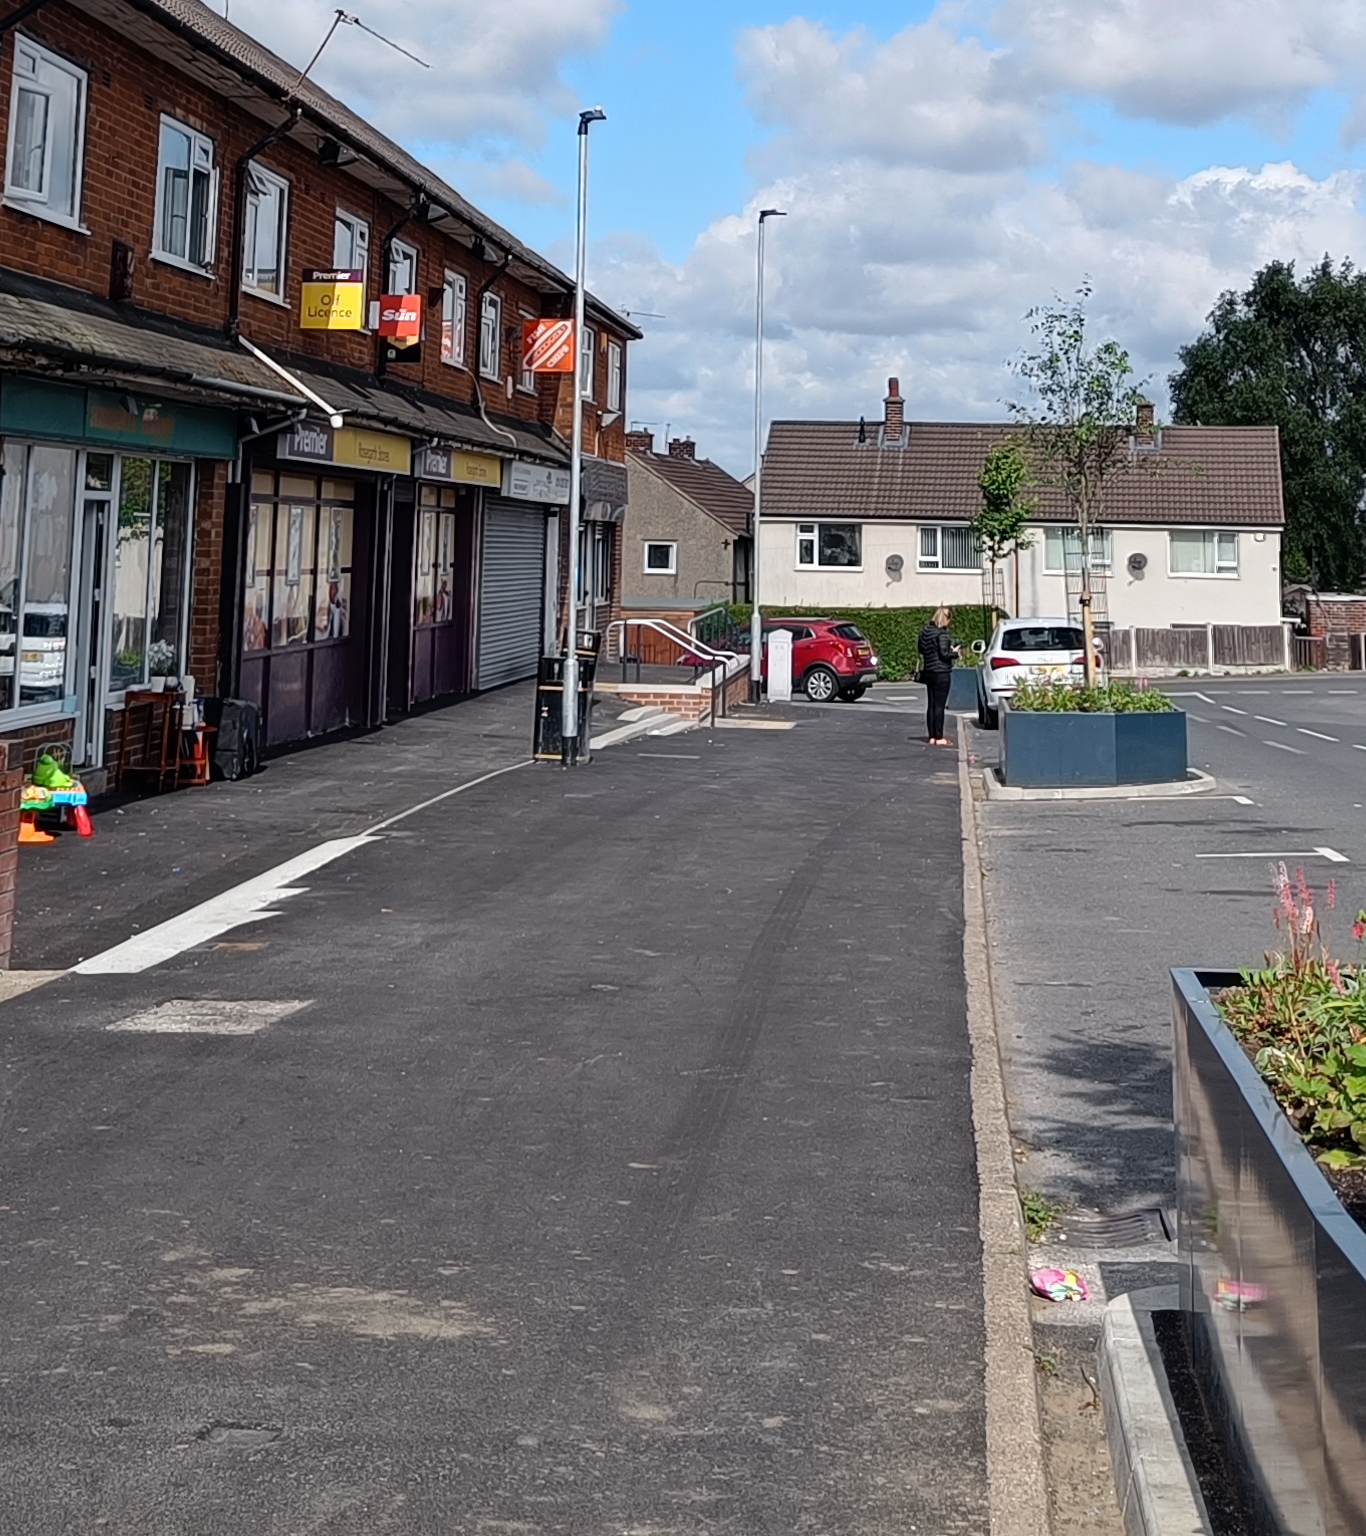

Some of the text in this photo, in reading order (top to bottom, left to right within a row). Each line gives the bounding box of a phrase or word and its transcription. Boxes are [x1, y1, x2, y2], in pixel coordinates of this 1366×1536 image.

[312, 271, 351, 280] Premier
[320, 294, 341, 306] Of
[307, 306, 352, 318] Licence
[381, 309, 417, 321] Sun
[294, 424, 328, 455] Premier
